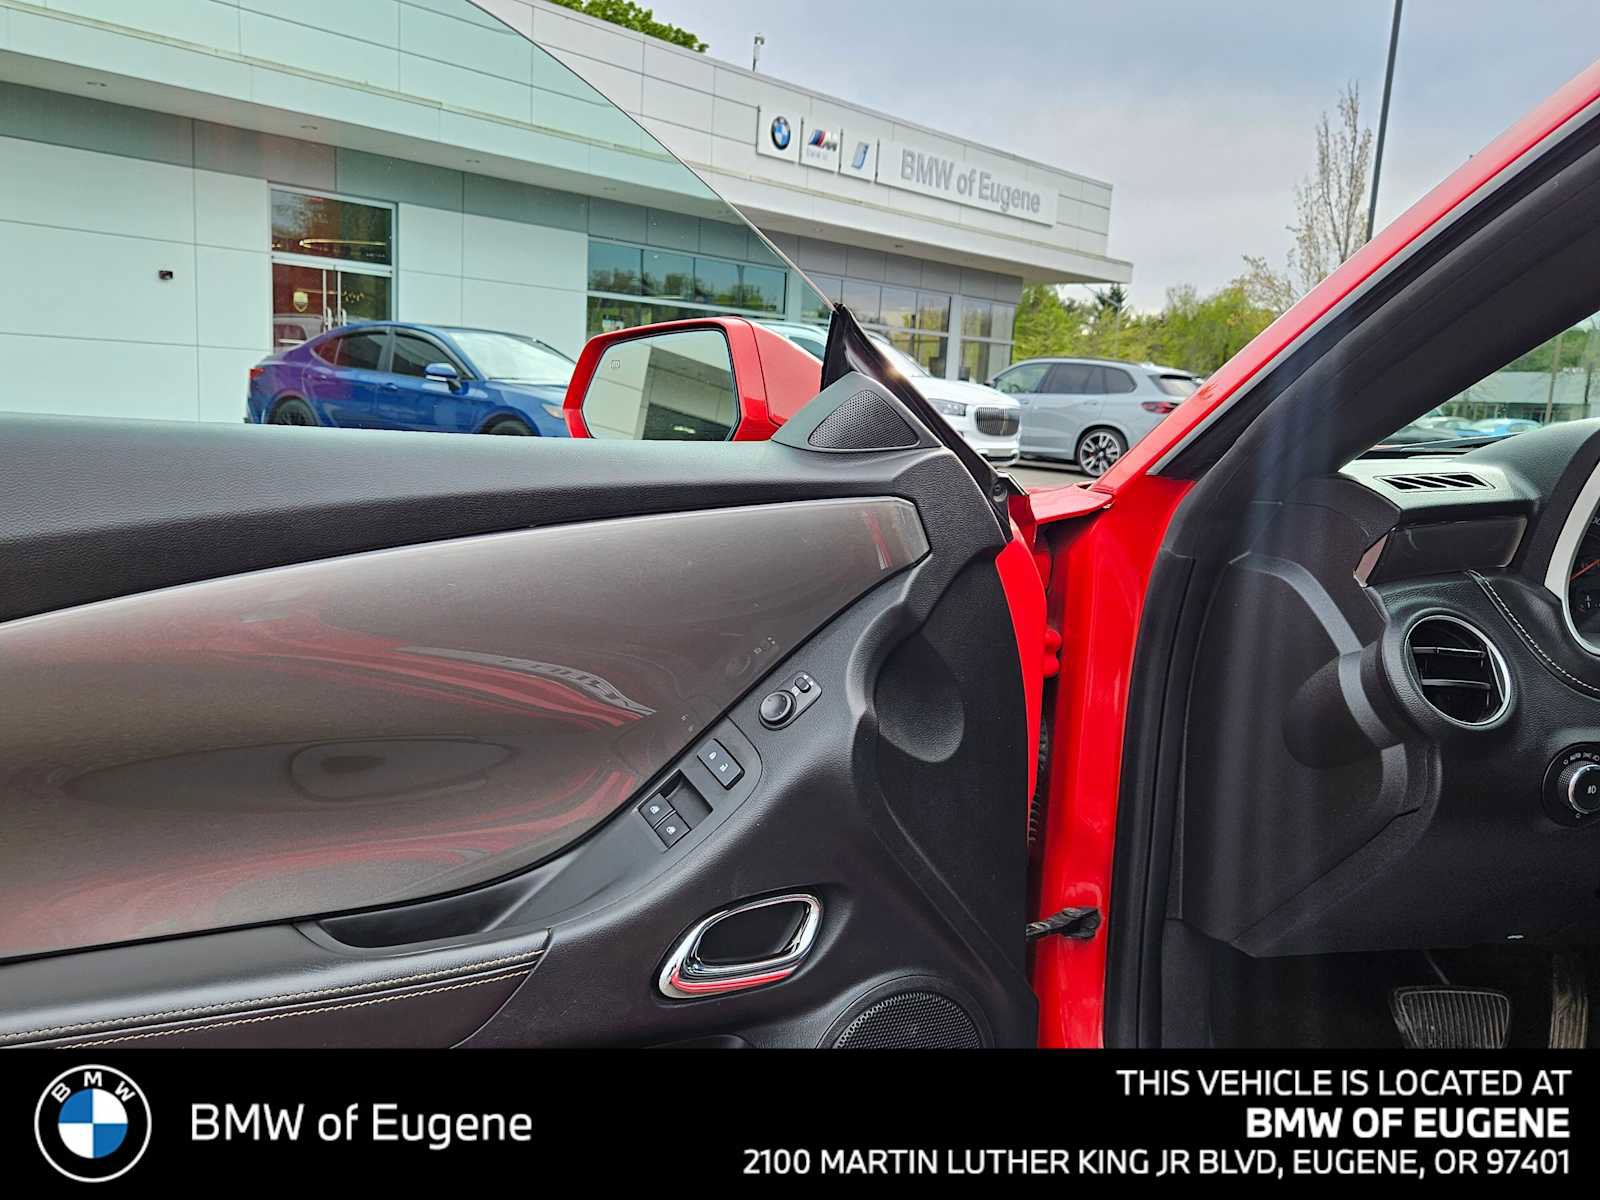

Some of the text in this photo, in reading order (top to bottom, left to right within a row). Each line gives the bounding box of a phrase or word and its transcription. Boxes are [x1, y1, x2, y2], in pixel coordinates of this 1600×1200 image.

[901, 149, 1041, 214] BMW of Eugene
